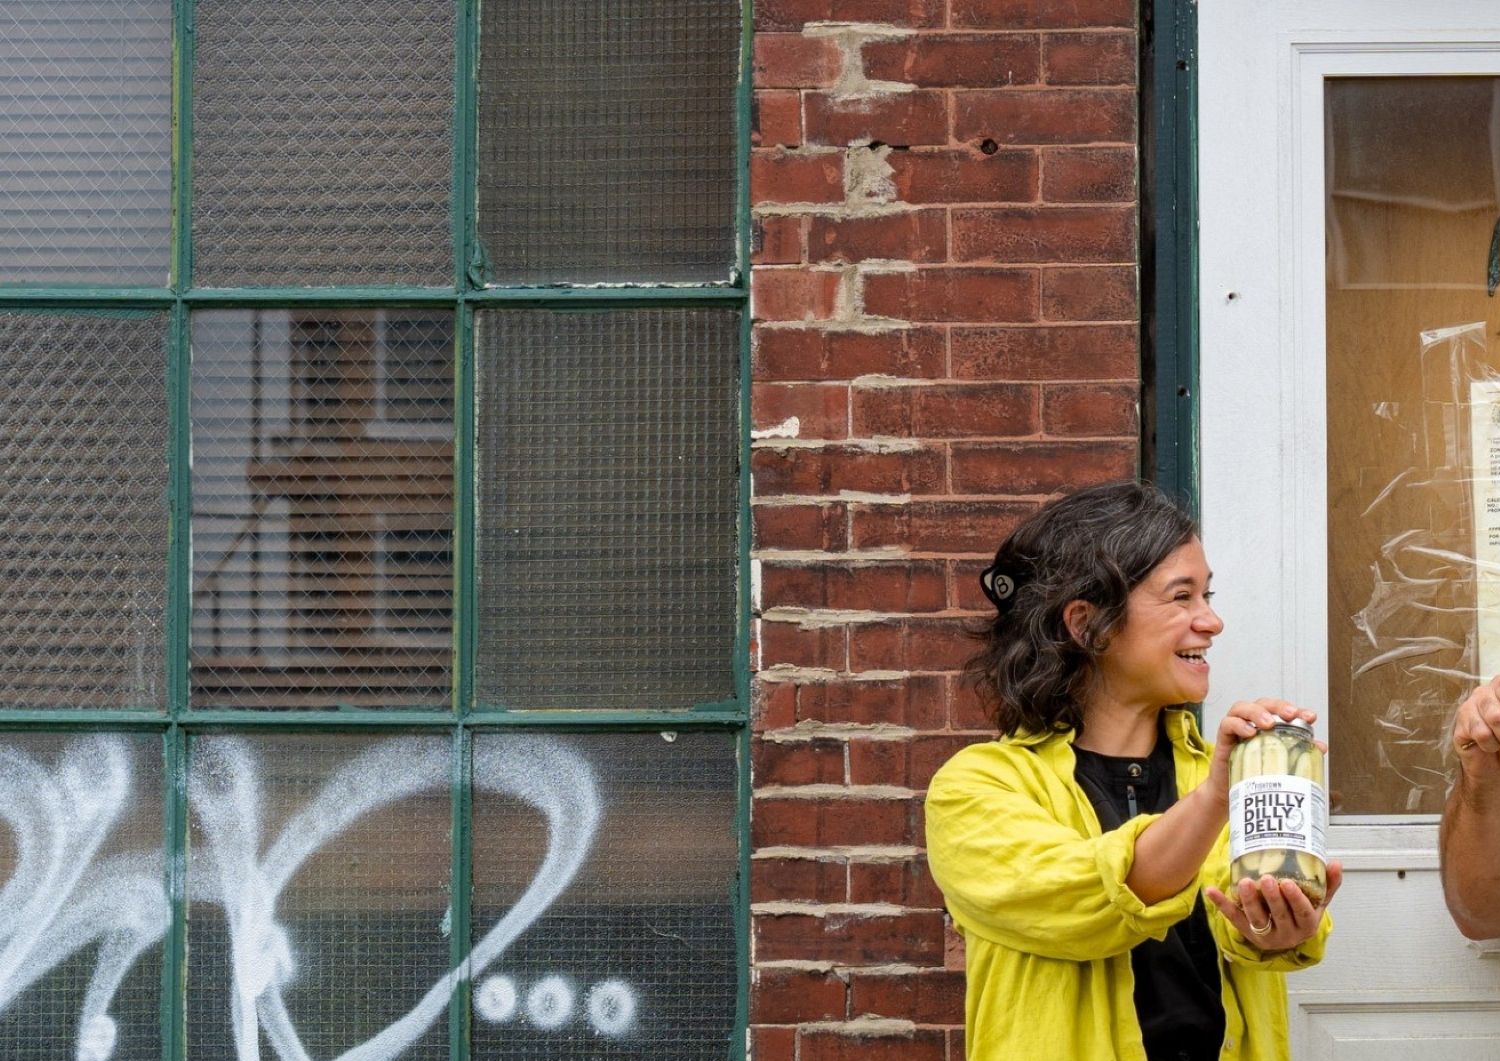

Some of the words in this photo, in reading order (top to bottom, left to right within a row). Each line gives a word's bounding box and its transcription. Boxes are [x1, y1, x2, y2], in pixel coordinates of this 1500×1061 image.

[997, 576, 1008, 594] 8
[1244, 793, 1305, 810] PHILLY
[1244, 806, 1293, 823] DILLY
[1244, 818, 1283, 835] DELI
